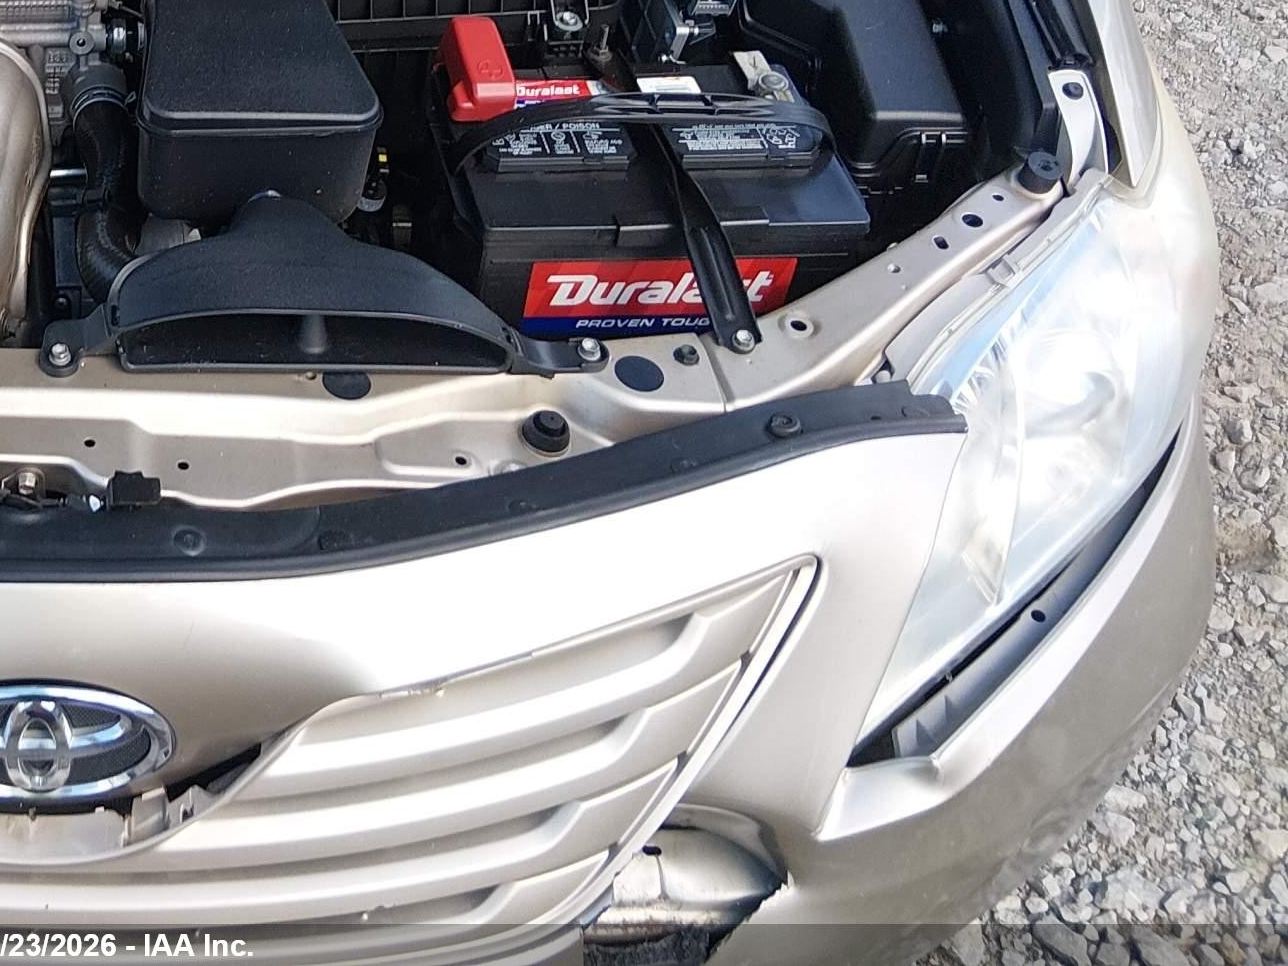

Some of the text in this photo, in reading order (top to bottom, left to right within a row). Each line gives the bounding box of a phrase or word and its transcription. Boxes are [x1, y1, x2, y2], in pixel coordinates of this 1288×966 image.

[516, 84, 580, 97] Duralast
[562, 122, 600, 131] POISON
[547, 270, 774, 307] Duralat
[575, 316, 711, 329] PROVEN TOUG
